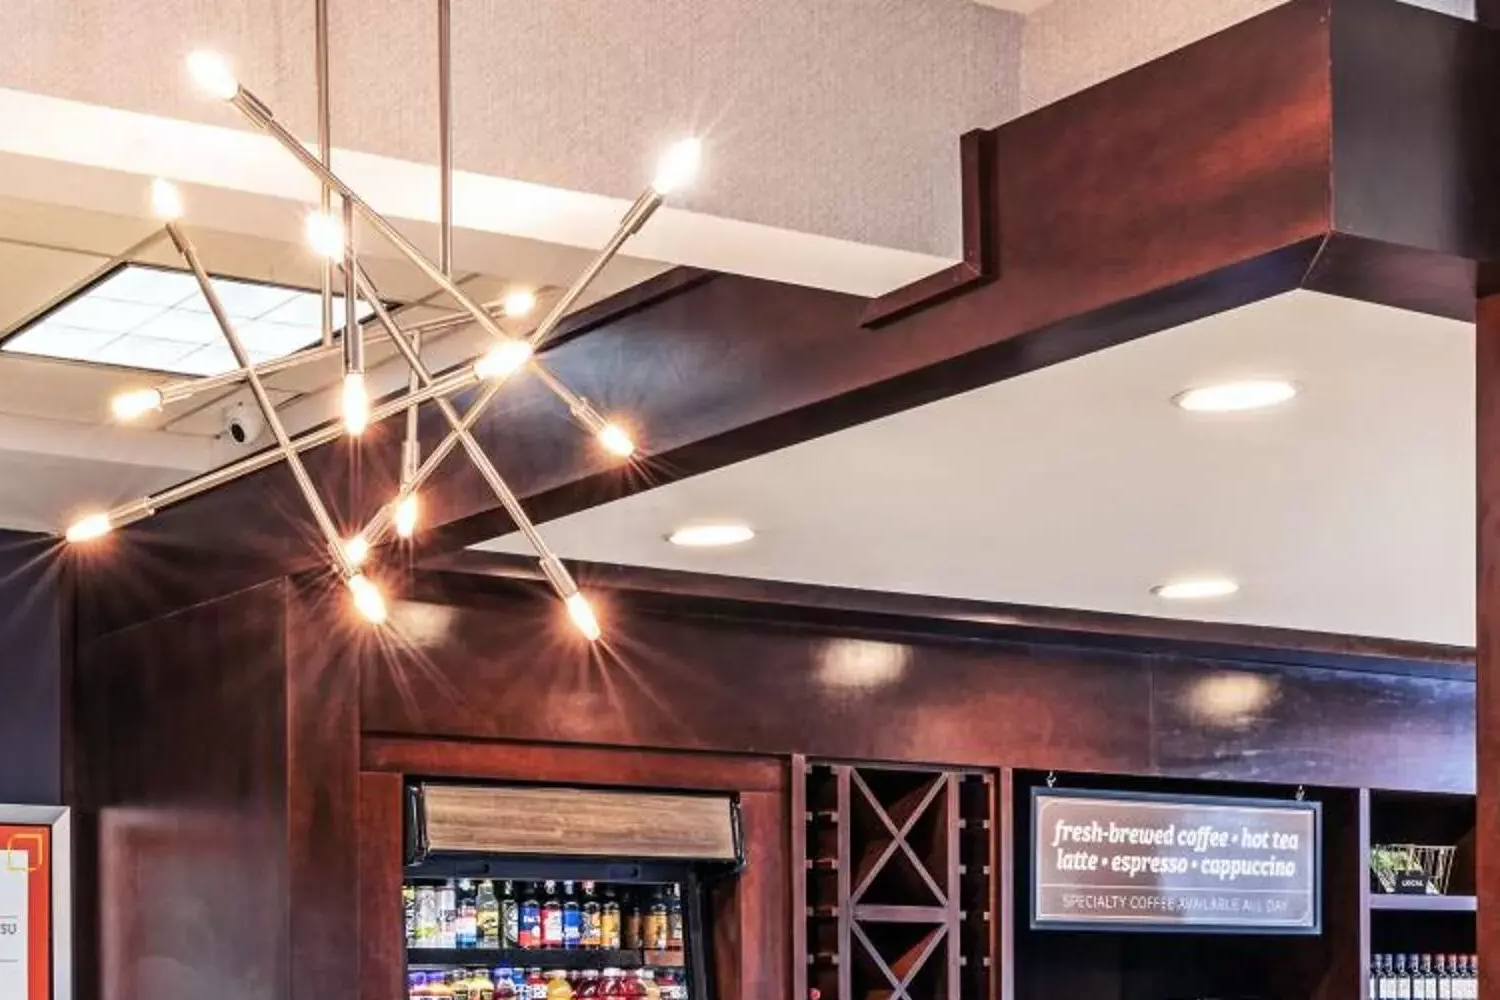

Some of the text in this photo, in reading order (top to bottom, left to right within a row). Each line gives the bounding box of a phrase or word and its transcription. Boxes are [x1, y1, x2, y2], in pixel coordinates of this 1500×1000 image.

[1053, 820, 1299, 852] fresh-brewed coffee hot tea
[1056, 848, 1296, 881] latte espresso cappuccino
[1062, 894, 1289, 913] SPECIALTY COFFEE AVAILABLE ALL DAY
[0, 923, 17, 935] SU
